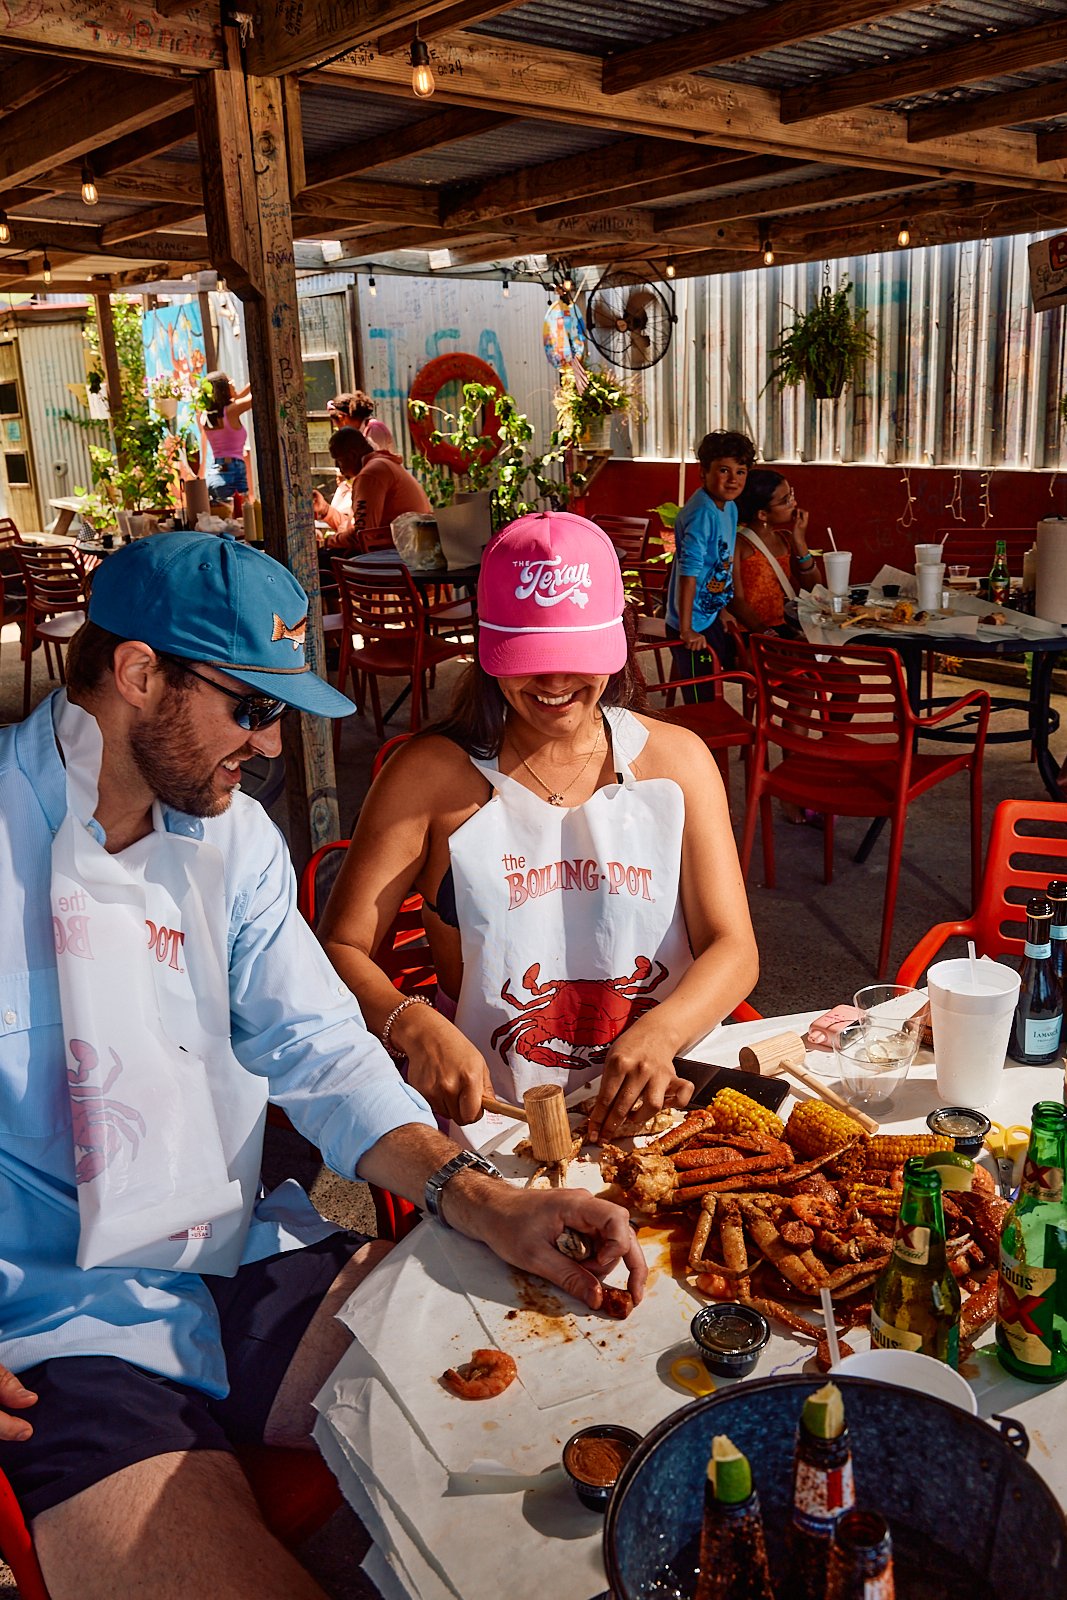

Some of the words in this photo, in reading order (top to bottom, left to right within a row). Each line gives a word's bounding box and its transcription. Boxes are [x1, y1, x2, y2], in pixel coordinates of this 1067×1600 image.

[515, 555, 592, 607] Texan
[502, 854, 526, 872] the
[504, 859, 600, 911] BOILING
[606, 861, 653, 902] POT
